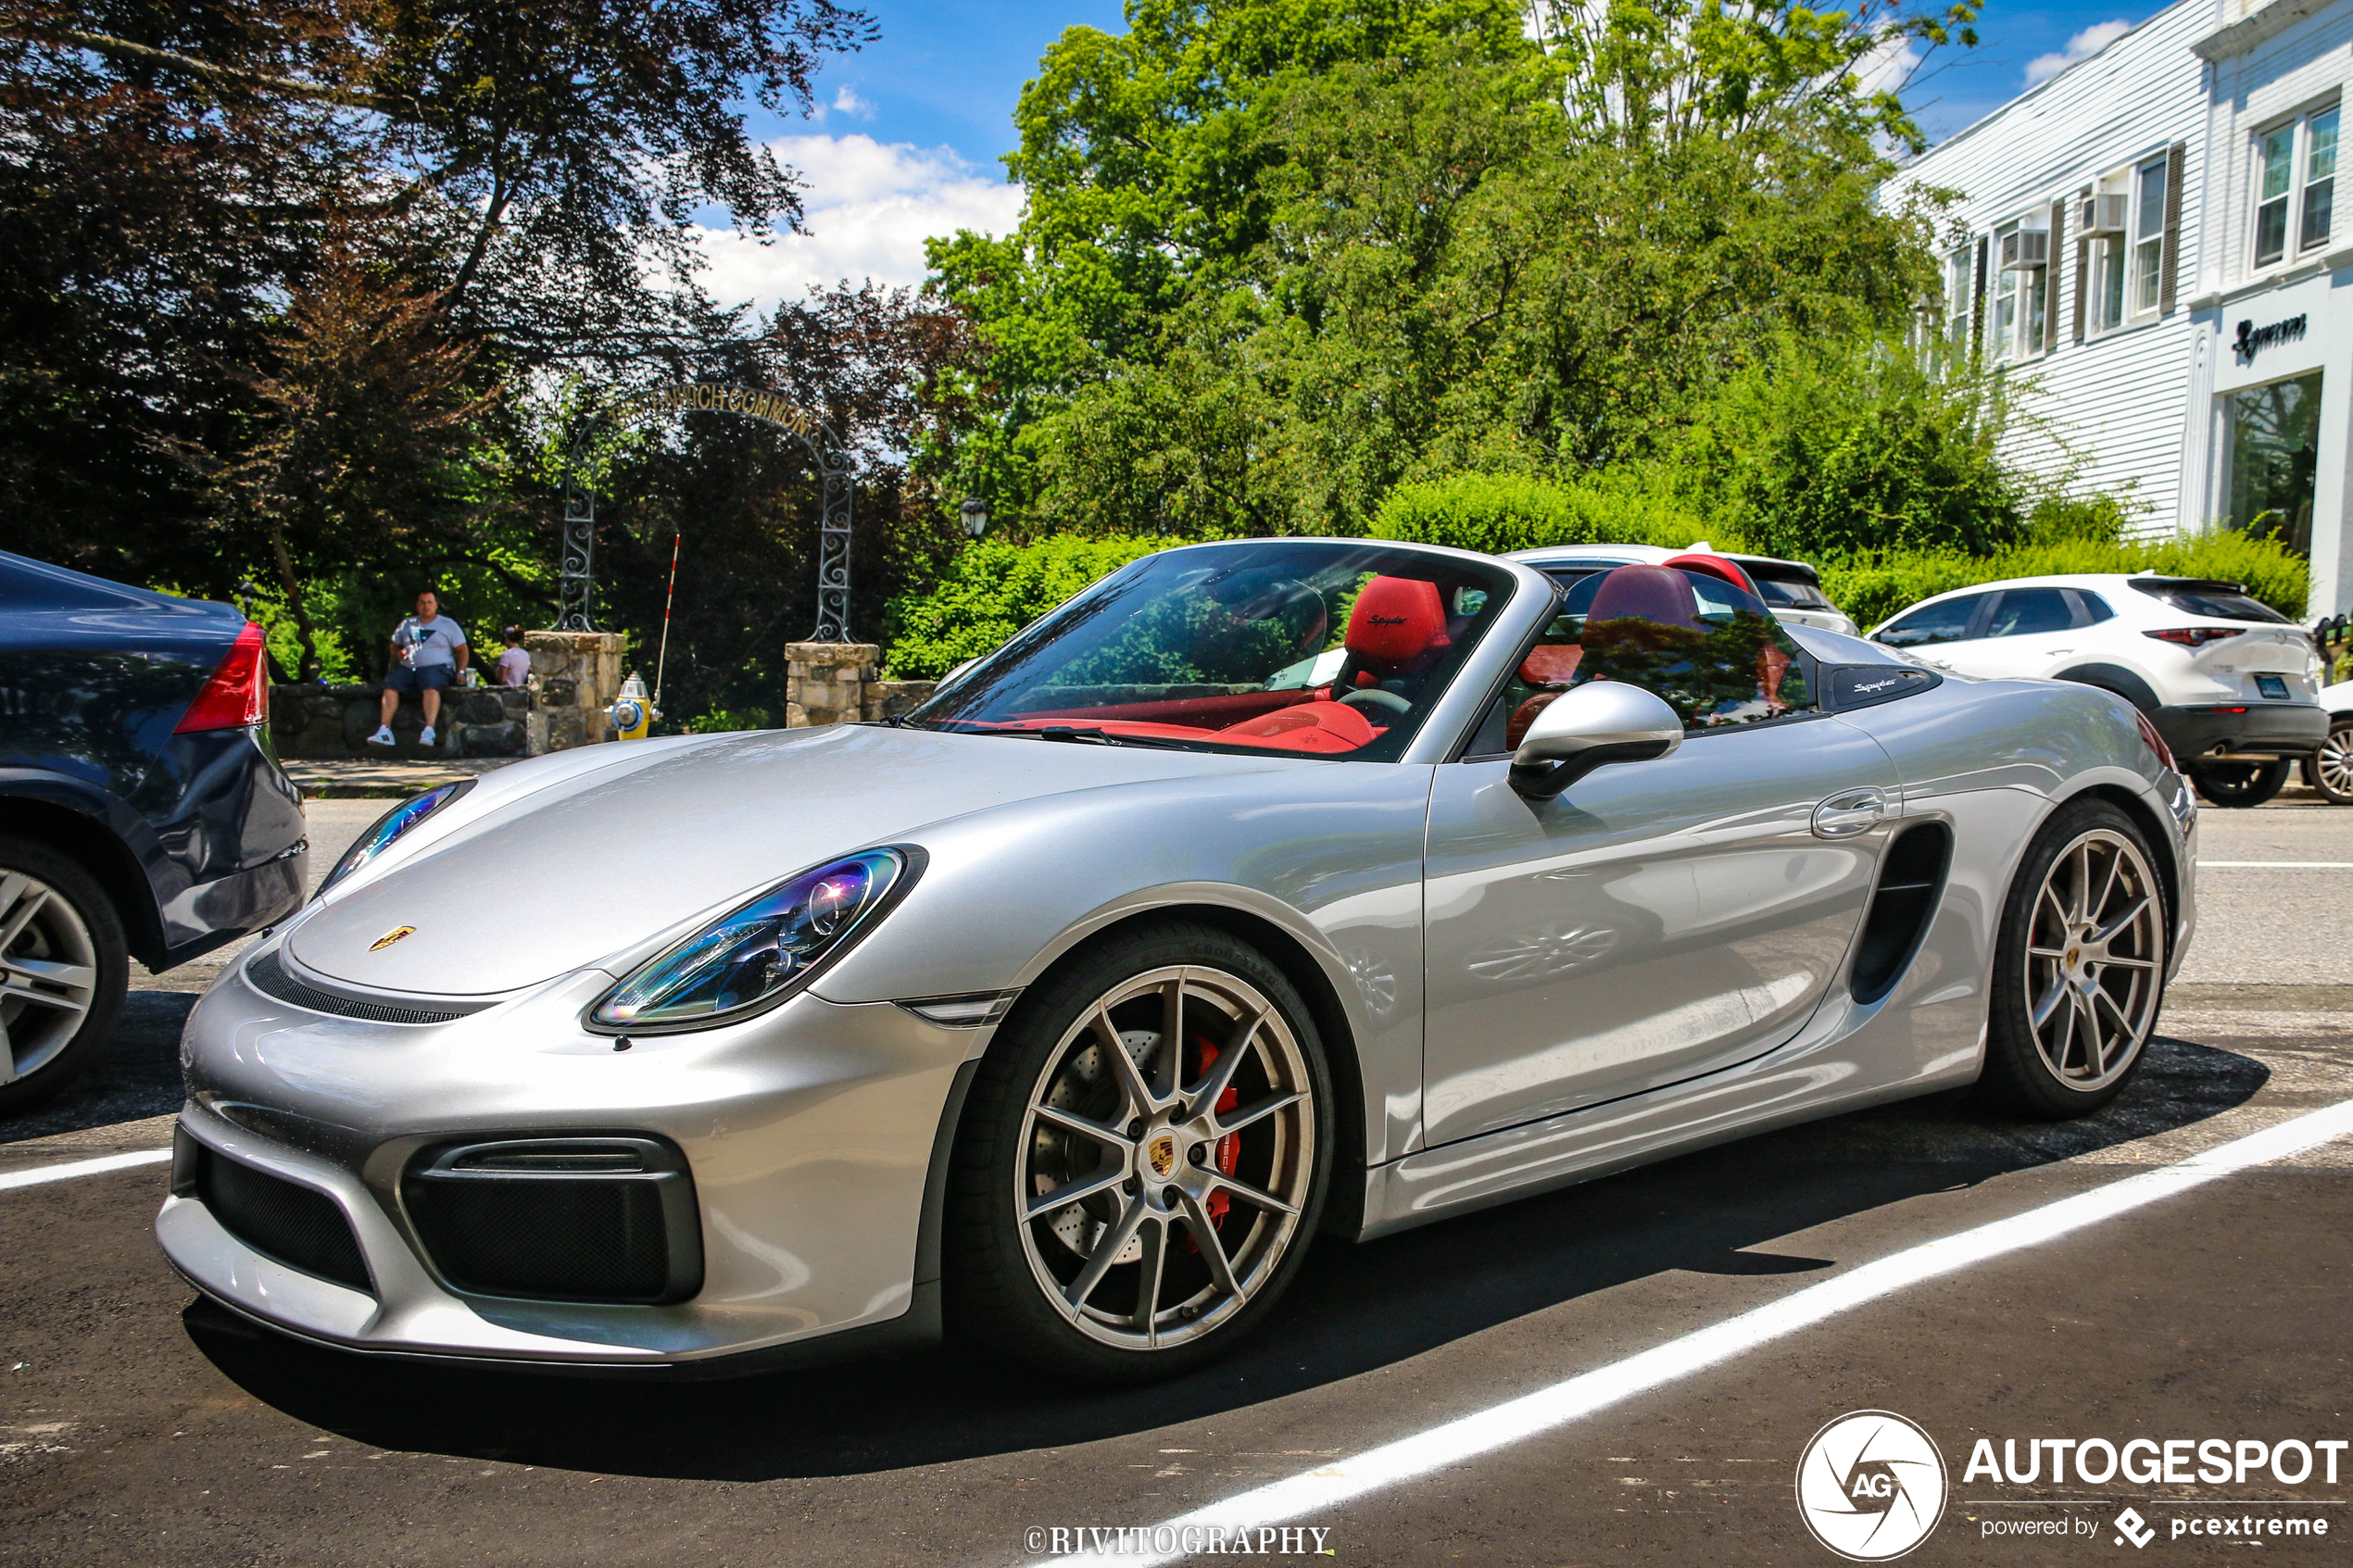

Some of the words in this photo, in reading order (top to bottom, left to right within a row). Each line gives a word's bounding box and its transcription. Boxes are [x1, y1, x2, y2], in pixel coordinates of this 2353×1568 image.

[727, 389, 813, 436] COMMON
[1367, 615, 1407, 627] Spyder
[1854, 679, 1896, 693] Spyder
